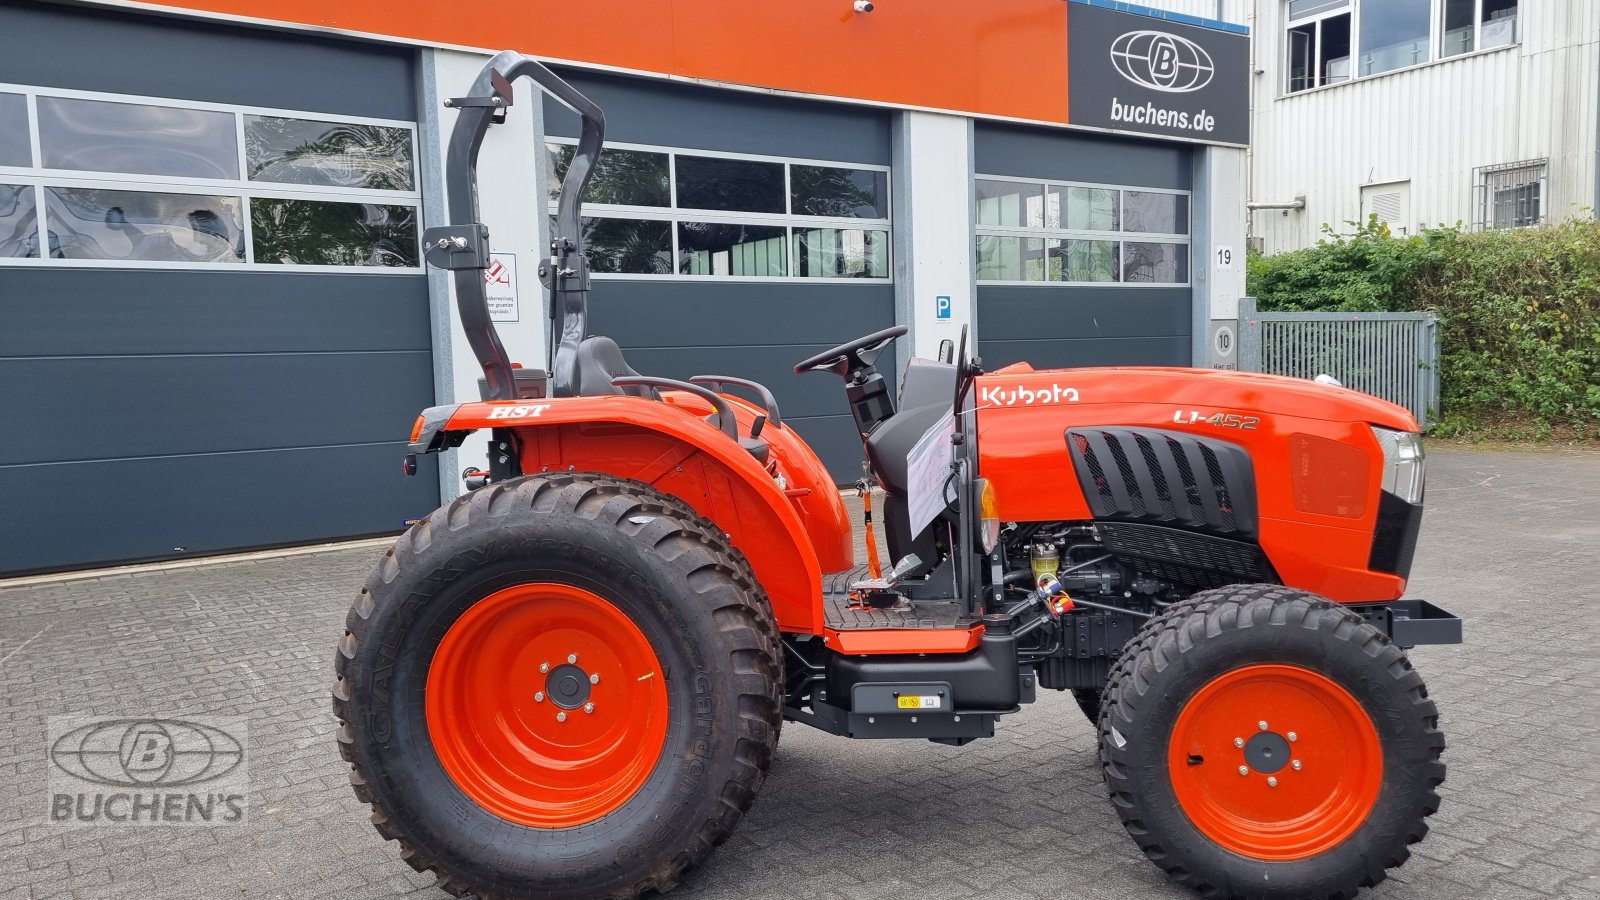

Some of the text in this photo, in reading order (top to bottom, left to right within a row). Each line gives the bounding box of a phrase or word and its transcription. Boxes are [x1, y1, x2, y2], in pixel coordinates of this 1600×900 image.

[1110, 98, 1215, 132] buchens.de
[1217, 249, 1231, 265] 19
[937, 298, 949, 317] P
[1219, 335, 1229, 347] 10
[982, 383, 1080, 406] Kubota
[486, 404, 551, 420] HST
[1173, 409, 1261, 431] L1-452
[679, 670, 714, 797] Garden
